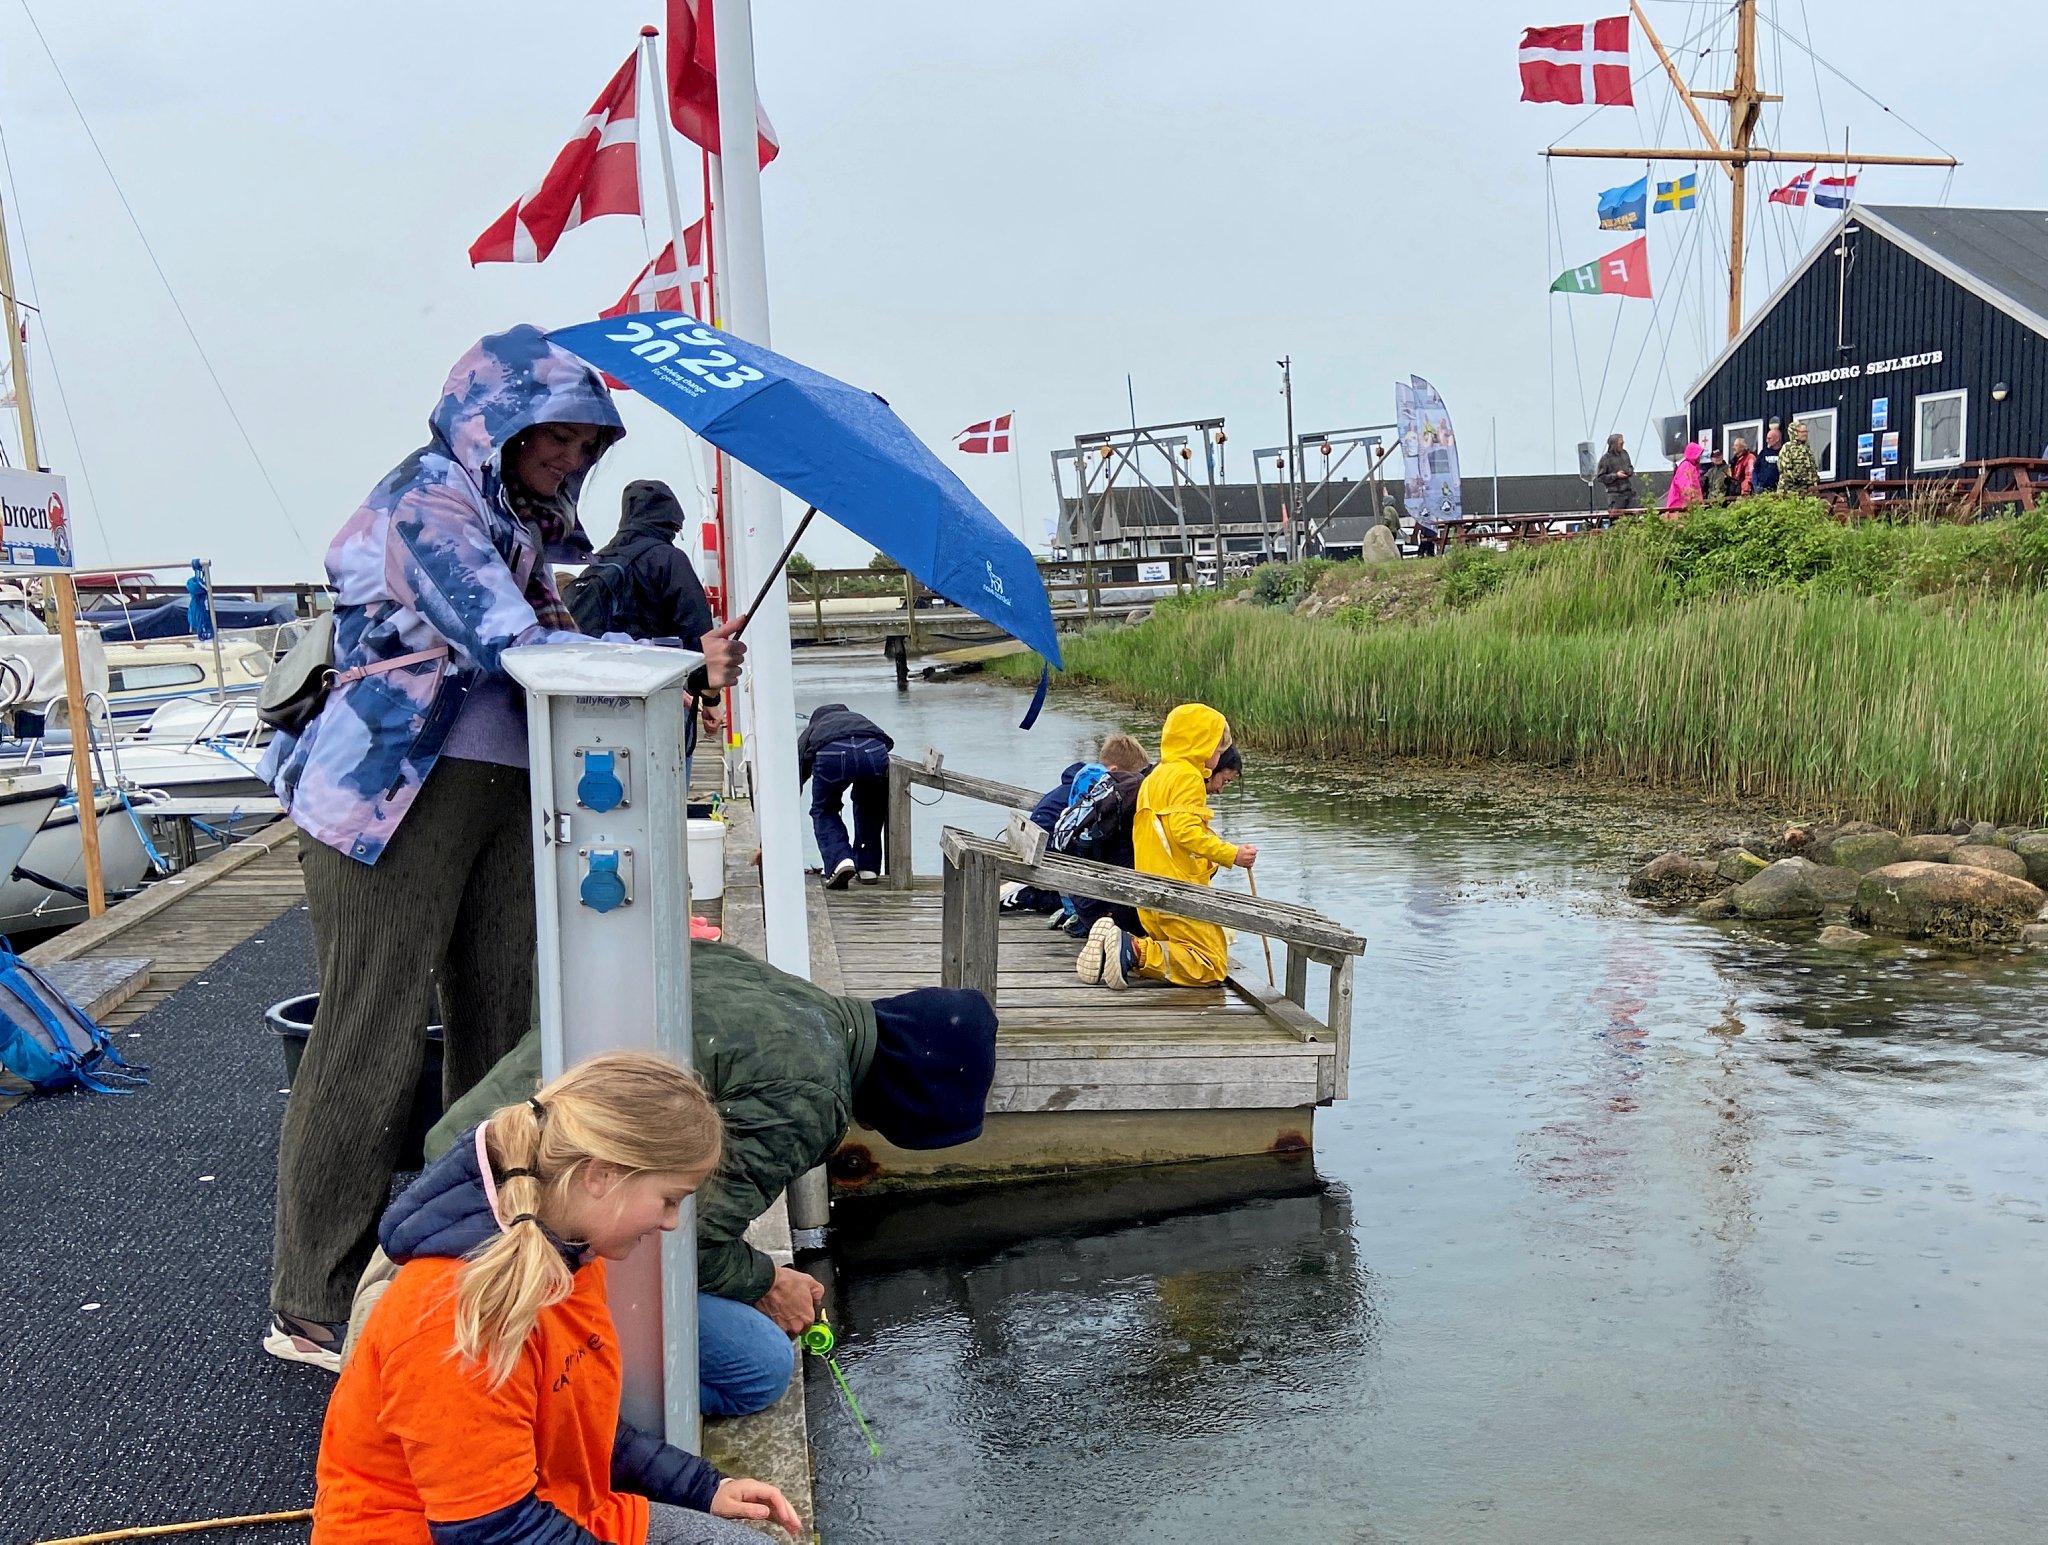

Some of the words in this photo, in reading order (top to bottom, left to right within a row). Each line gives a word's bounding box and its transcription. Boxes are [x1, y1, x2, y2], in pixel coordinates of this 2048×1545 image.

[1766, 365, 1861, 391] KALUNDBORG
[1864, 351, 1942, 375] SEJLKLUB
[1, 496, 48, 530] broen
